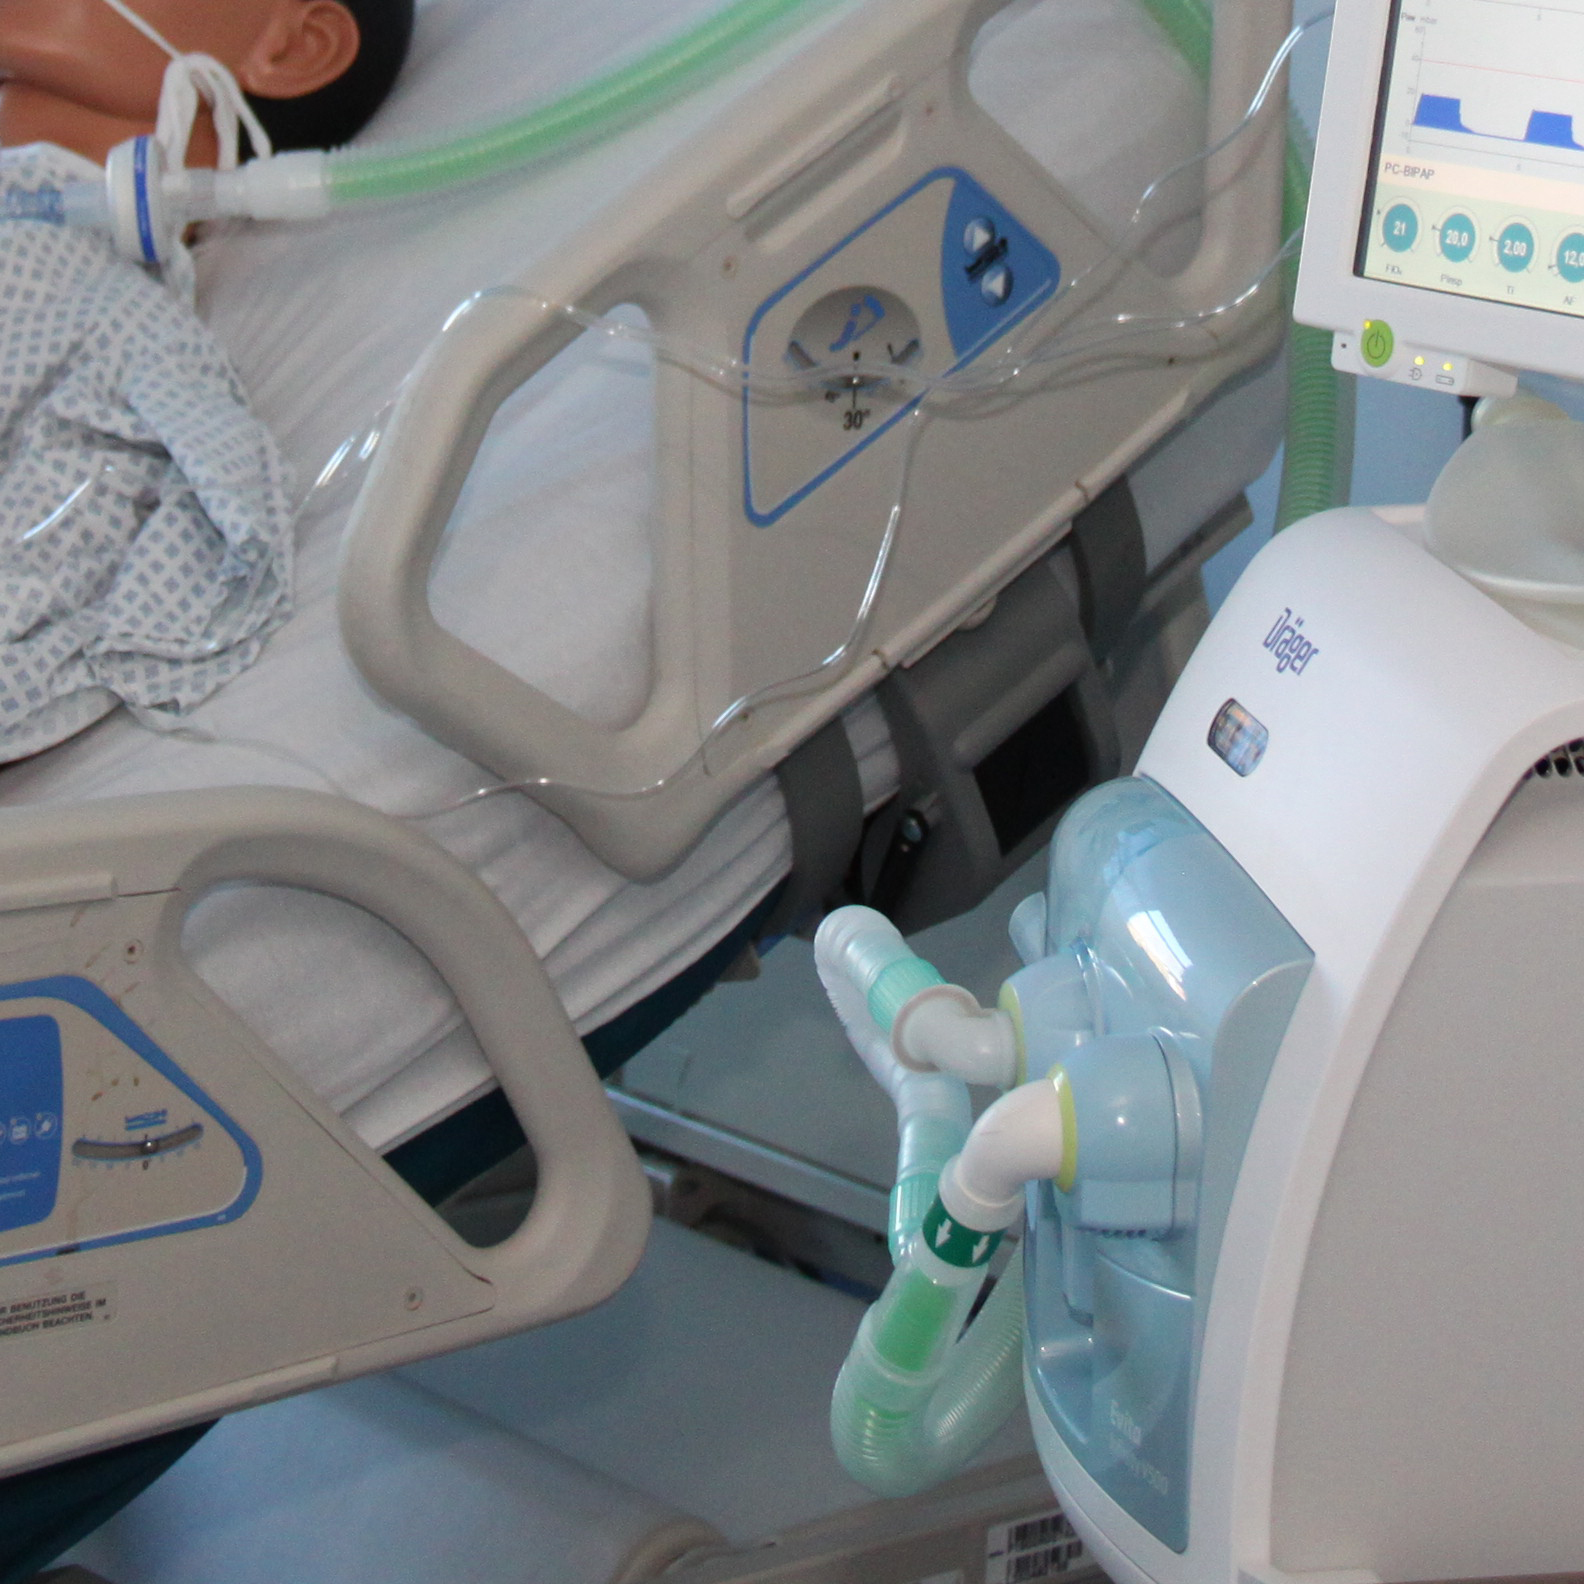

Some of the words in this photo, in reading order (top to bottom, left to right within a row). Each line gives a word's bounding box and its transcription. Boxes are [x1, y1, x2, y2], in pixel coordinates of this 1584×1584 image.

[1384, 160, 1435, 181] PC-BIPAP
[1393, 222, 1406, 236] 21
[1445, 229, 1469, 247] 20,0
[1503, 240, 1527, 258] 2,00
[1262, 607, 1320, 676] Dräger
